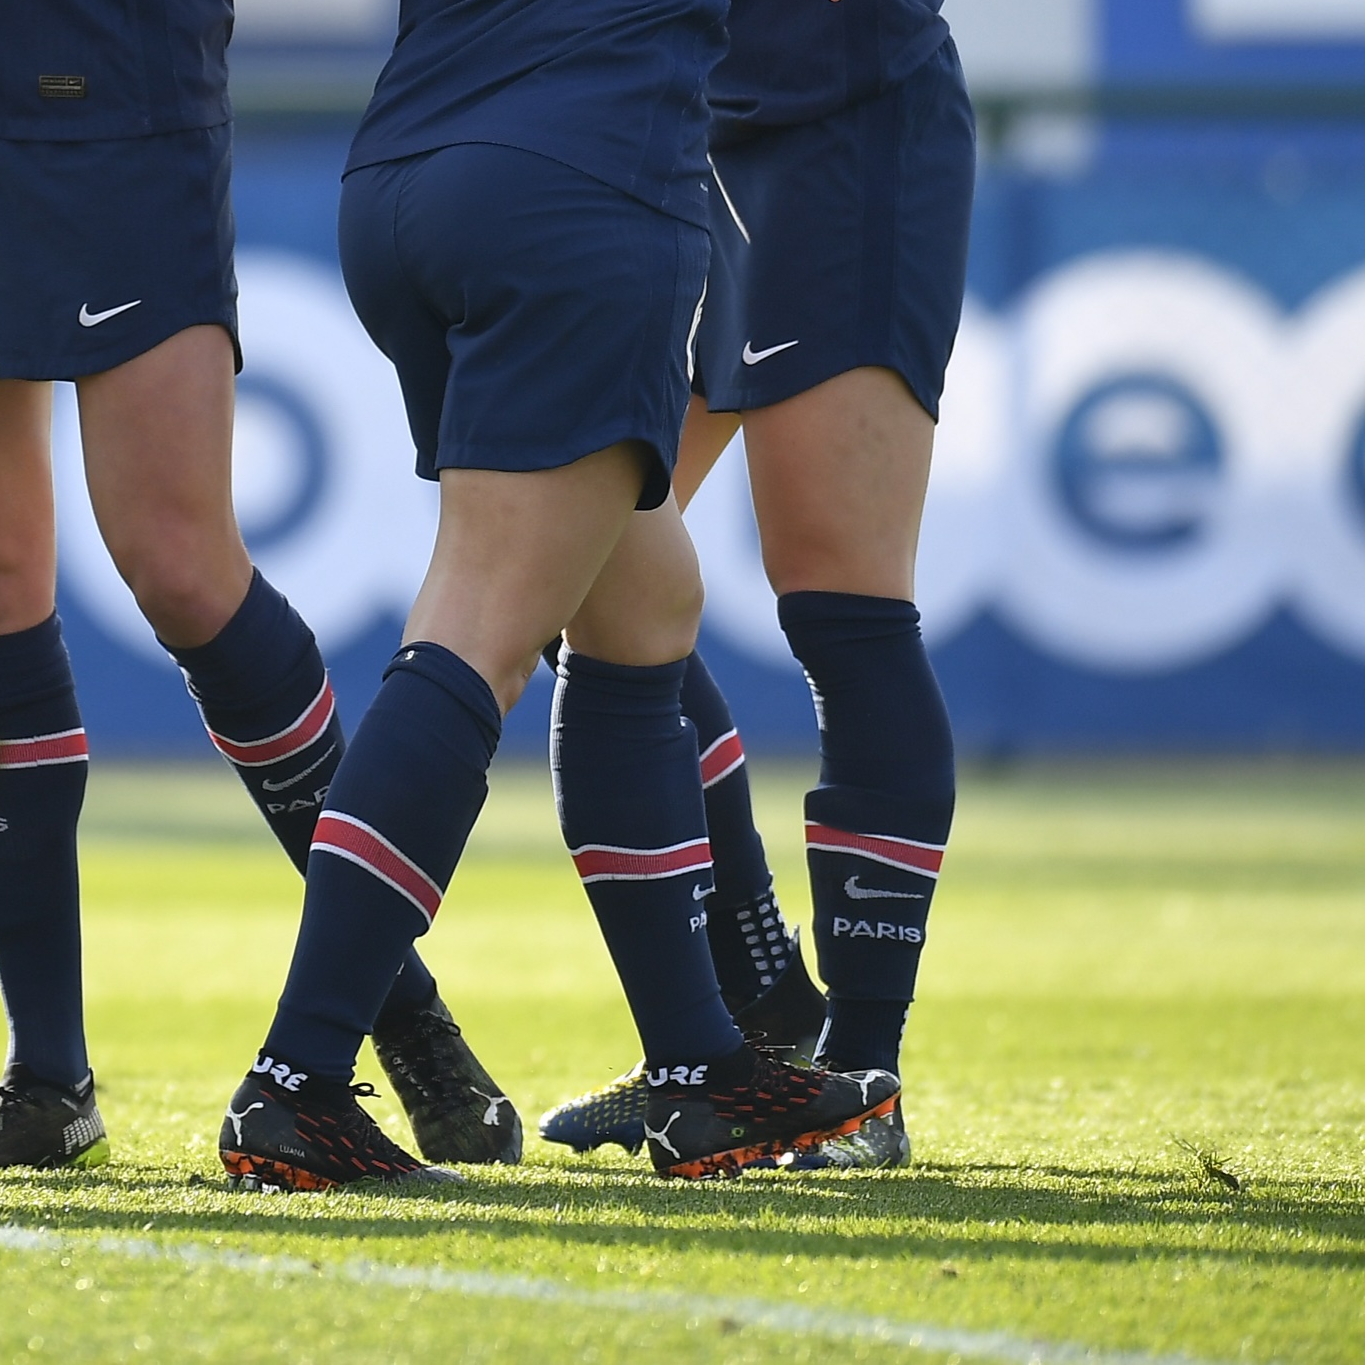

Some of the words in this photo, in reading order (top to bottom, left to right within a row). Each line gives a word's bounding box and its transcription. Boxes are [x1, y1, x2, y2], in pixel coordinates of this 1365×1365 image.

[267, 785, 330, 814] PAR
[832, 916, 922, 943] PARIS
[252, 1055, 308, 1091] URE
[647, 1064, 708, 1087] URE
[279, 1144, 305, 1158] LUANA
